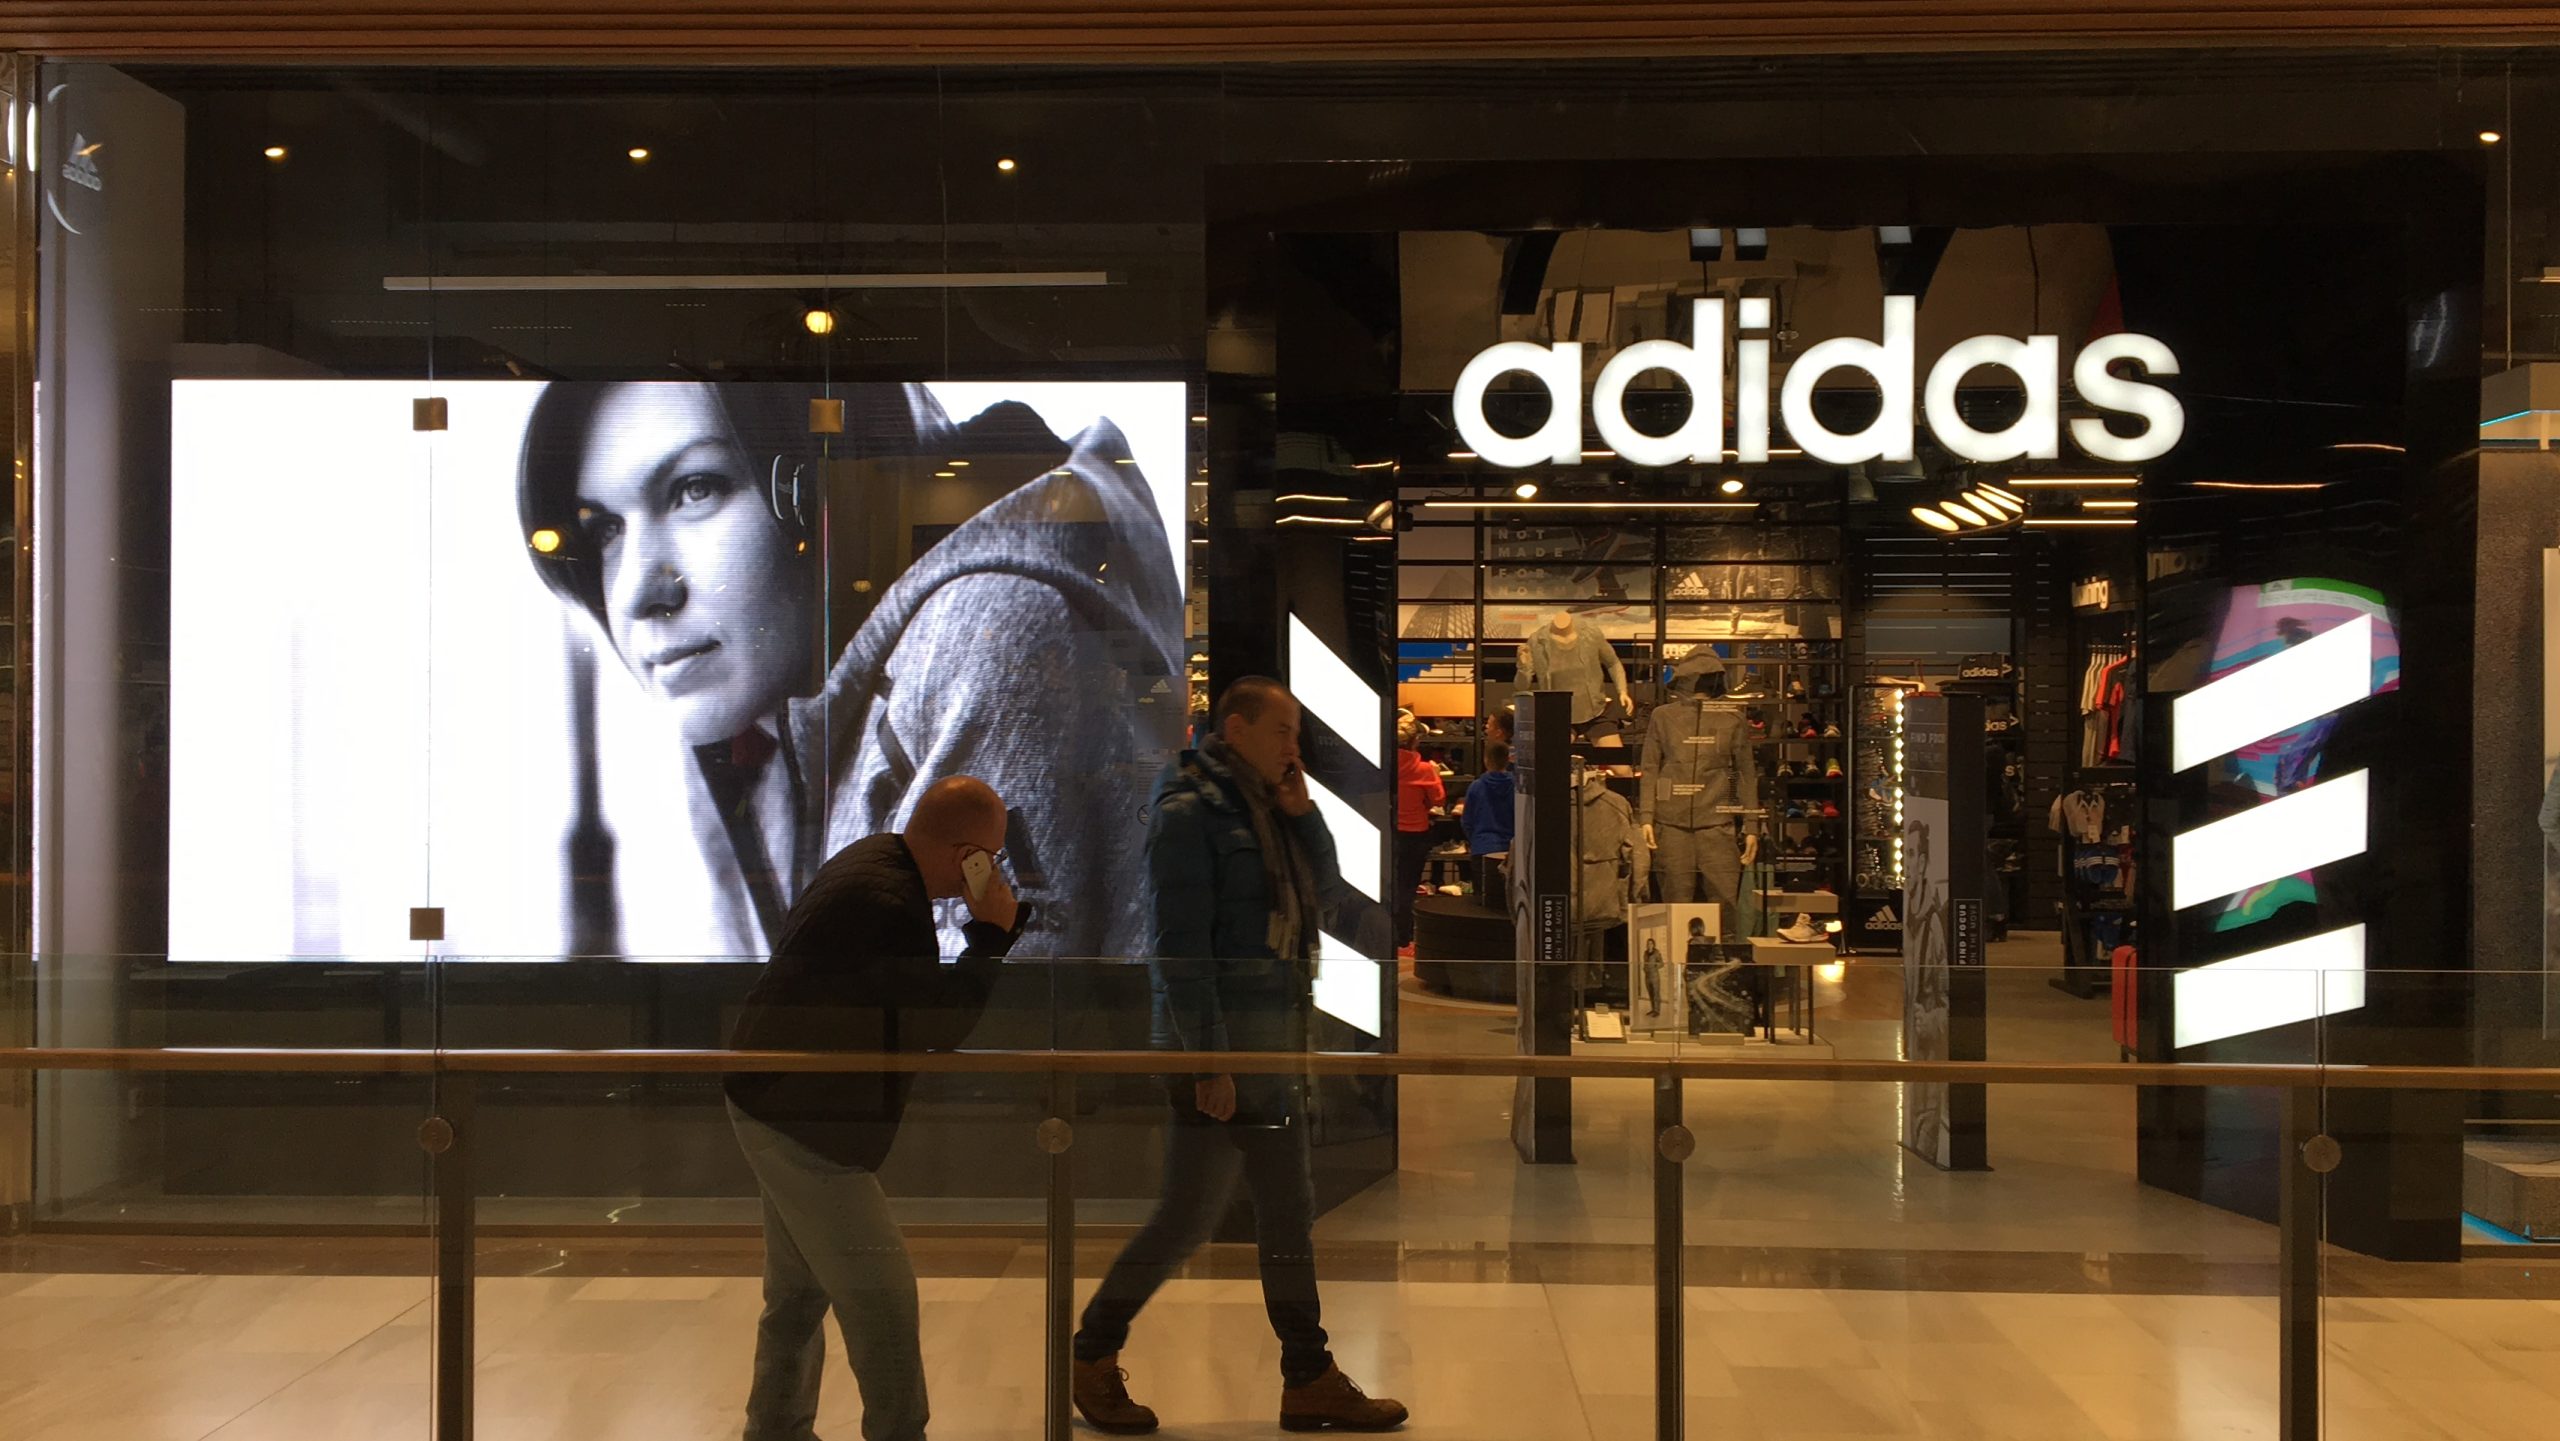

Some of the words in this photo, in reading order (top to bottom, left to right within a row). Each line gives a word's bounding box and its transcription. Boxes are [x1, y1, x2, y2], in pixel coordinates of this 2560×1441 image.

[1452, 295, 2186, 467] adidas
[1498, 529, 1545, 540] NOT
[1498, 547, 1563, 558] MADE
[1499, 568, 1545, 578] FOR
[1673, 587, 1710, 596] adidas
[1961, 667, 1999, 678] adidas
[1544, 900, 1552, 932] FOCUS
[1959, 904, 1967, 937] FOCUS
[1969, 904, 1977, 929] MOVE
[1544, 936, 1552, 960] FIND
[1959, 941, 1967, 965] FIND
